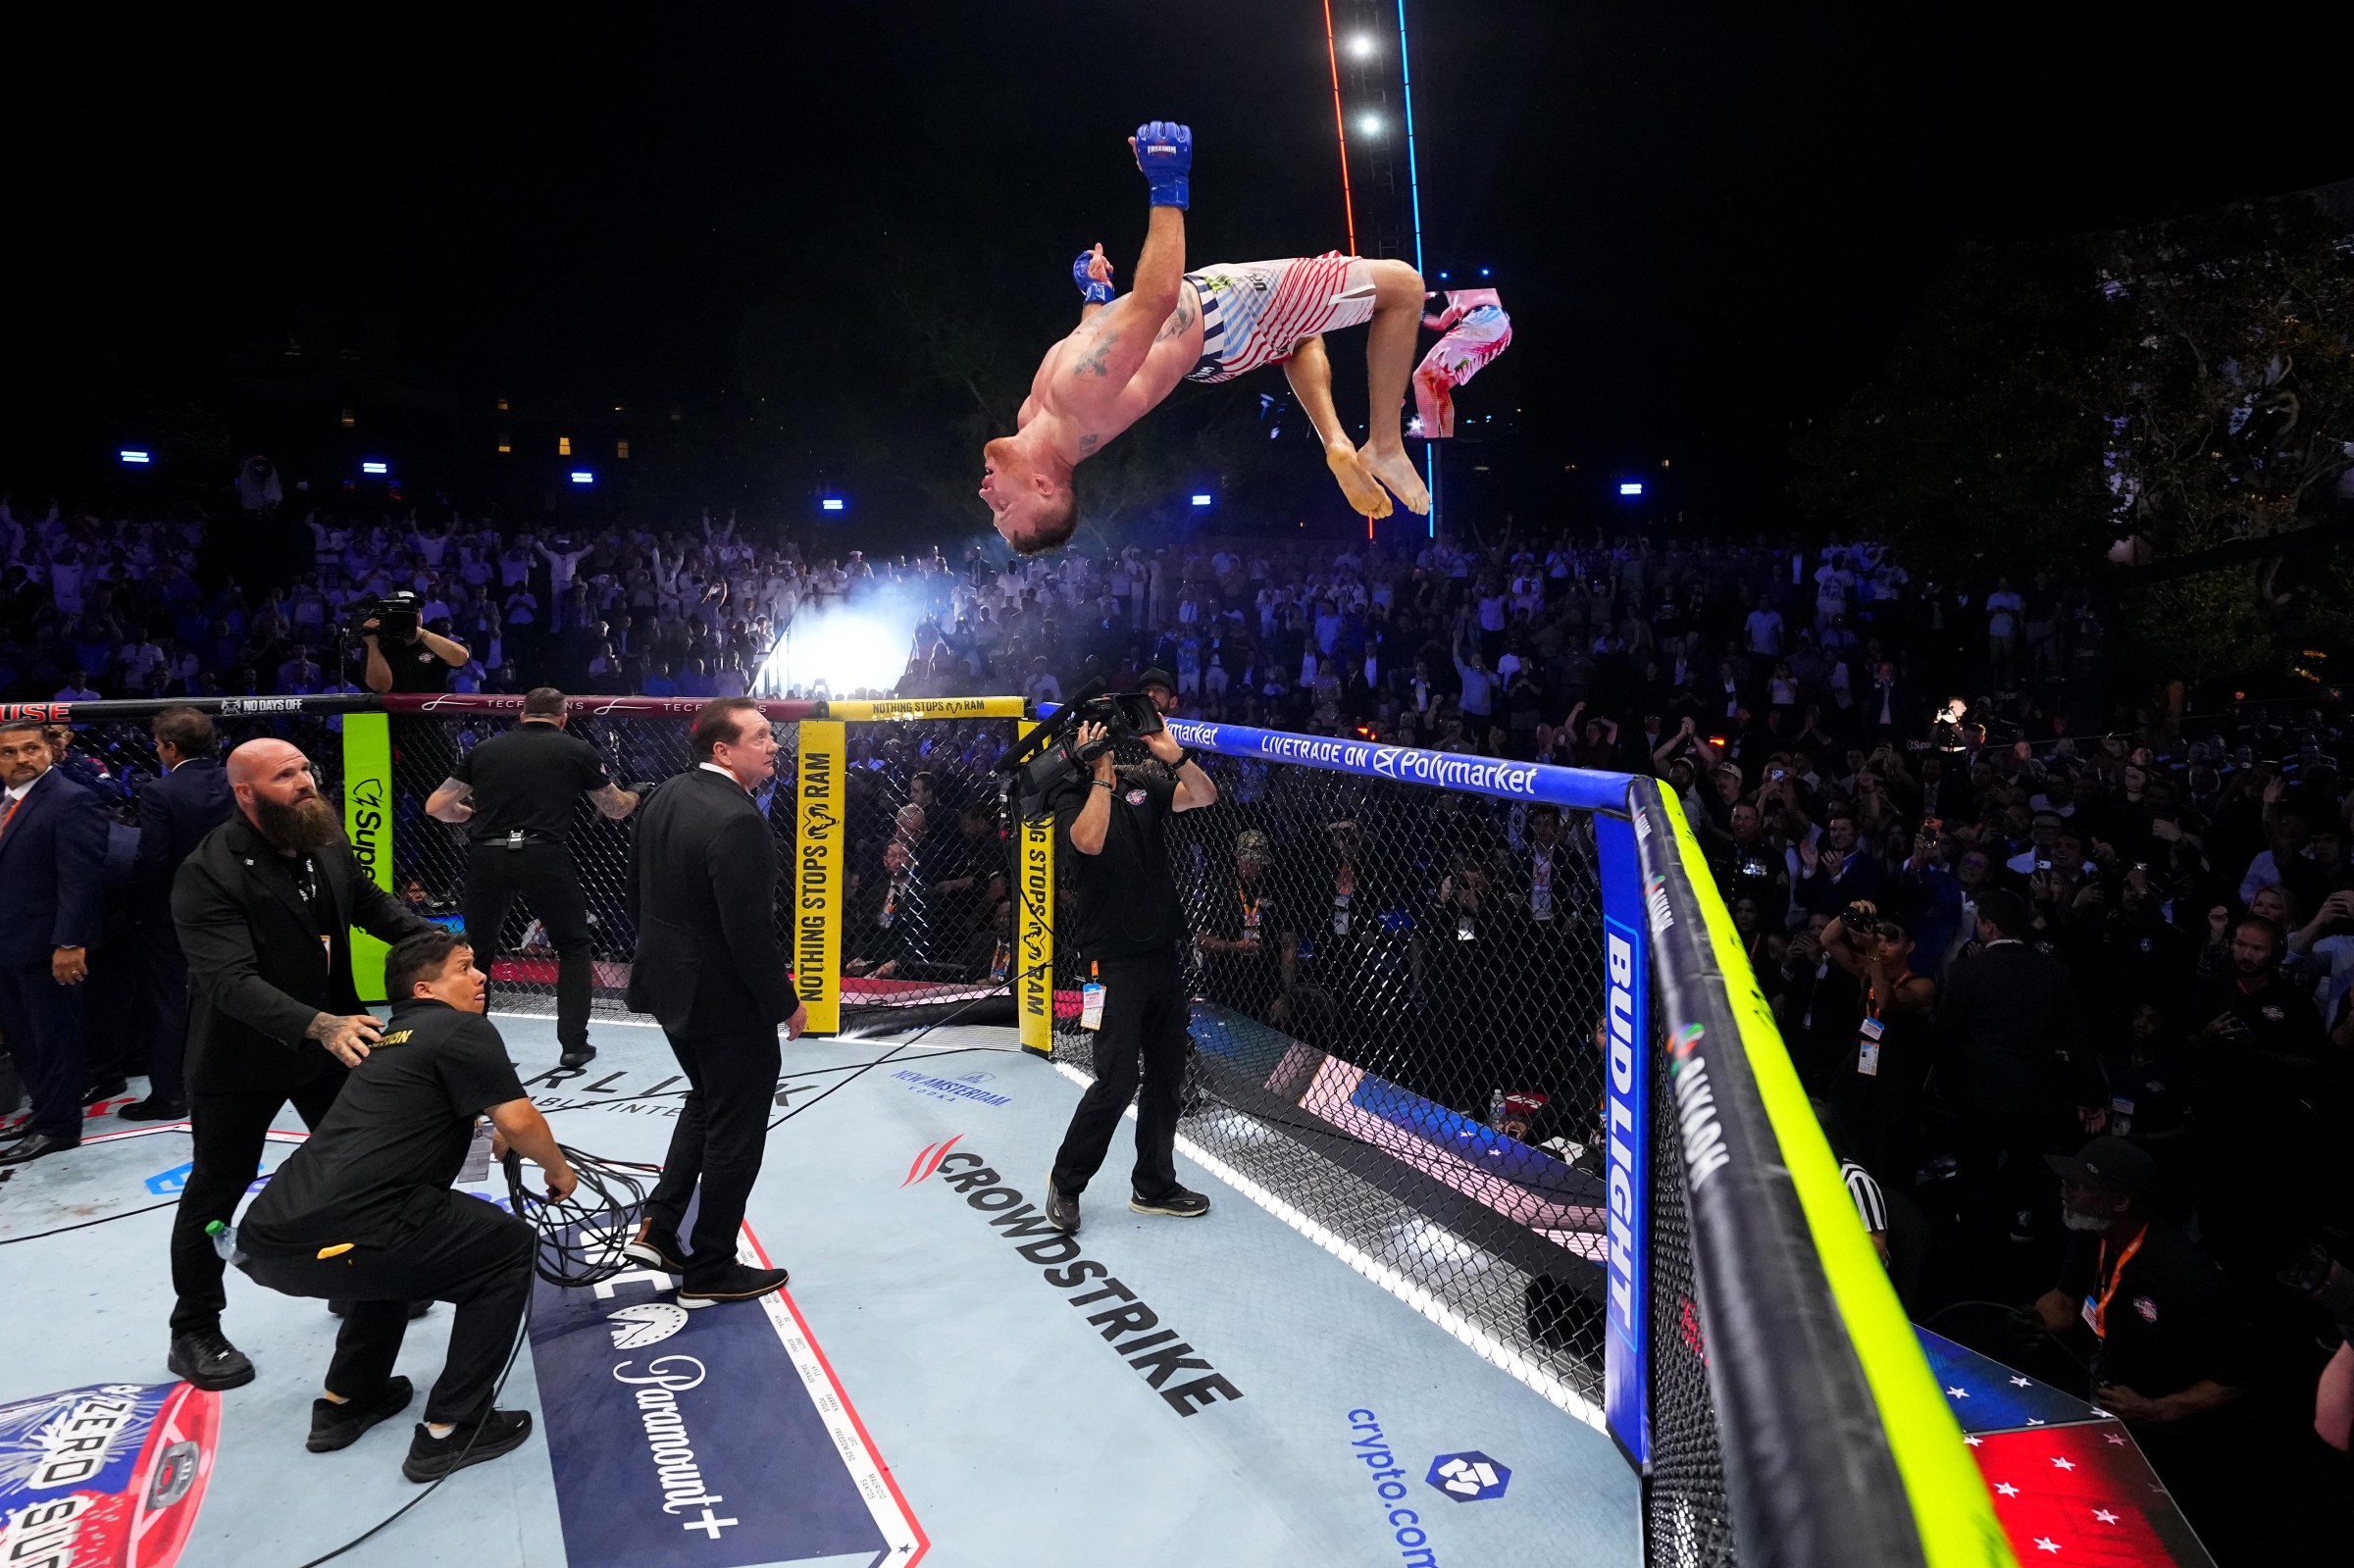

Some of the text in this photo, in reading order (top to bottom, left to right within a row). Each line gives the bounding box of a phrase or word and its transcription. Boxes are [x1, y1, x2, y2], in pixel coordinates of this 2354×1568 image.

[243, 698, 303, 712] NO DAYS OFF
[872, 699, 985, 714] NOTHING STOPS RAM
[1260, 735, 1538, 794] LIVETRADE ON Polymarket
[351, 809, 382, 883] Supe
[799, 752, 831, 1002] NOTHING STOPS RAM
[1029, 848, 1046, 918] STOPS
[1027, 962, 1045, 1017] RAM
[890, 1070, 1012, 1106] NEW AMSTERDAM
[908, 1086, 957, 1102] VODKA
[1609, 932, 1632, 1330] BUD LIGHT
[937, 1152, 1245, 1418] CROWDSTRIKE
[825, 1392, 839, 1412] DARREN
[42, 1402, 127, 1484] ZERO
[613, 1354, 739, 1540] Paramount+
[834, 1428, 850, 1451] FREEDOM
[859, 1478, 876, 1500] SANTOS
[868, 1473, 887, 1500] MAURICIO
[1348, 1408, 1439, 1568] crypto.com
